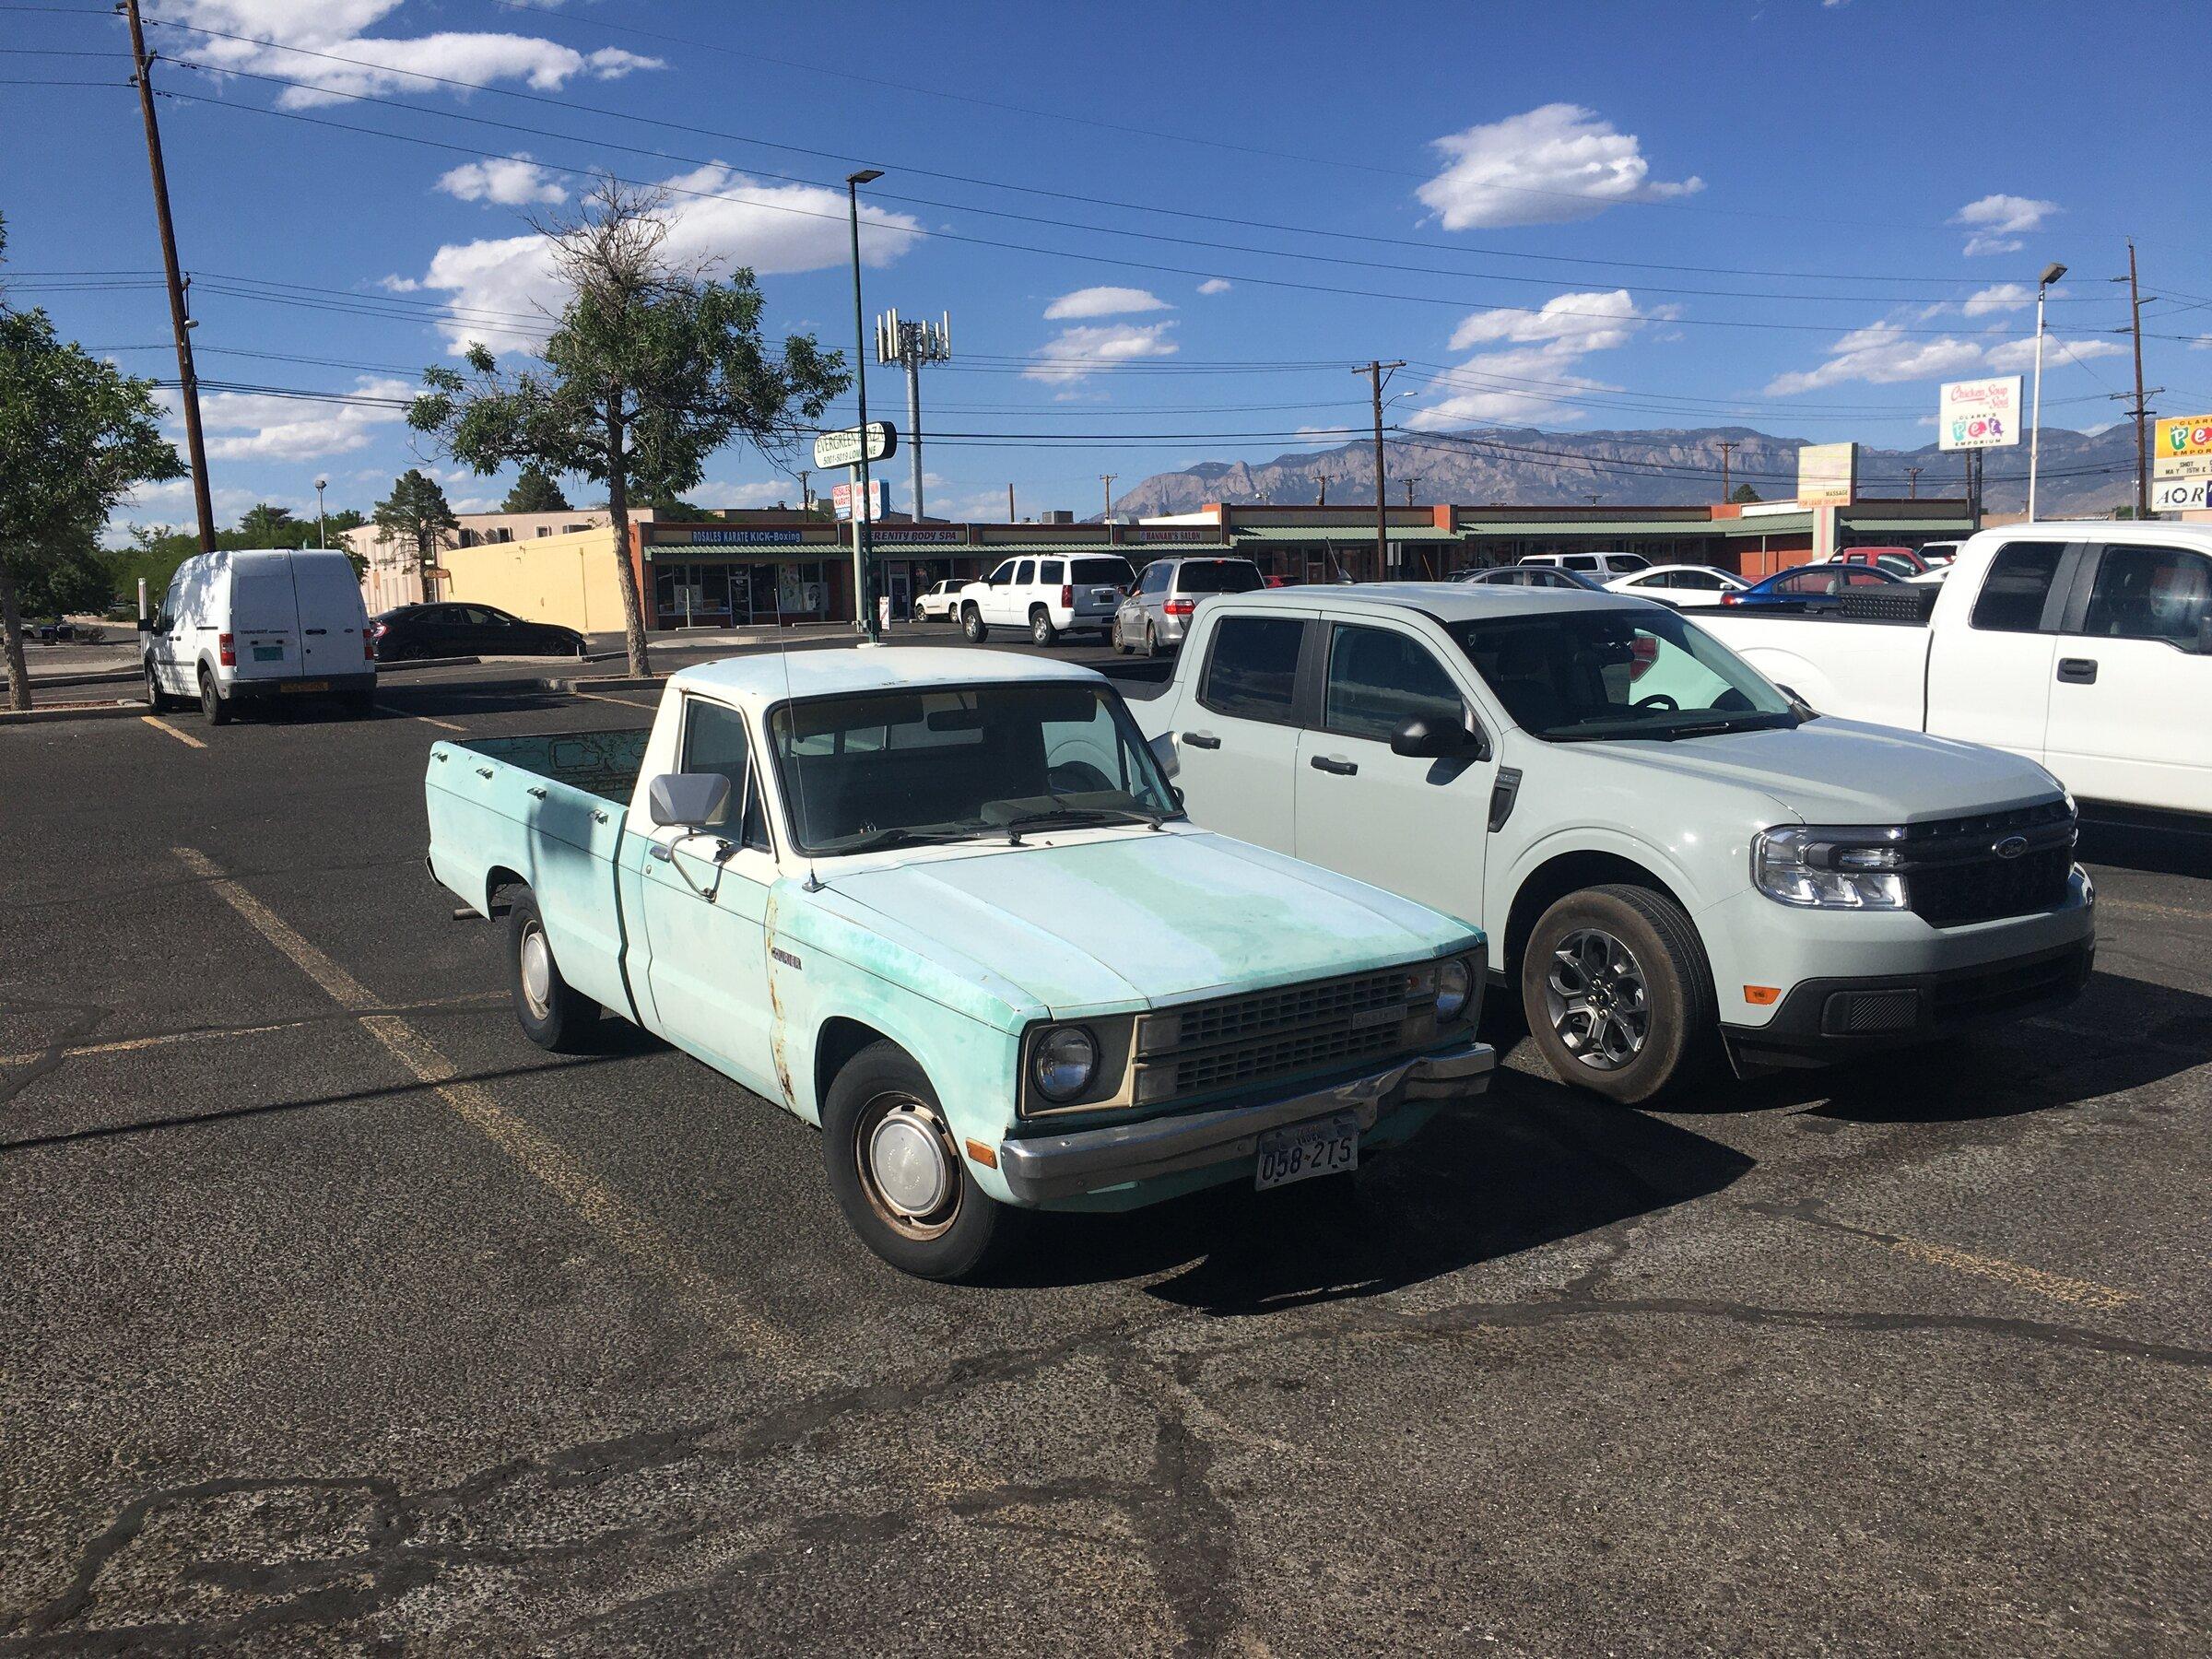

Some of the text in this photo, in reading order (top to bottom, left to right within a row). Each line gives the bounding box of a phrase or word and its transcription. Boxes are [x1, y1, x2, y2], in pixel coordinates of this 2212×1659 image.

[1955, 439, 2001, 447] EMPORIUM
[693, 531, 801, 543] ROSALES KARATE KICK-Boxing
[912, 532, 936, 540] BODY
[939, 532, 957, 540] SPA
